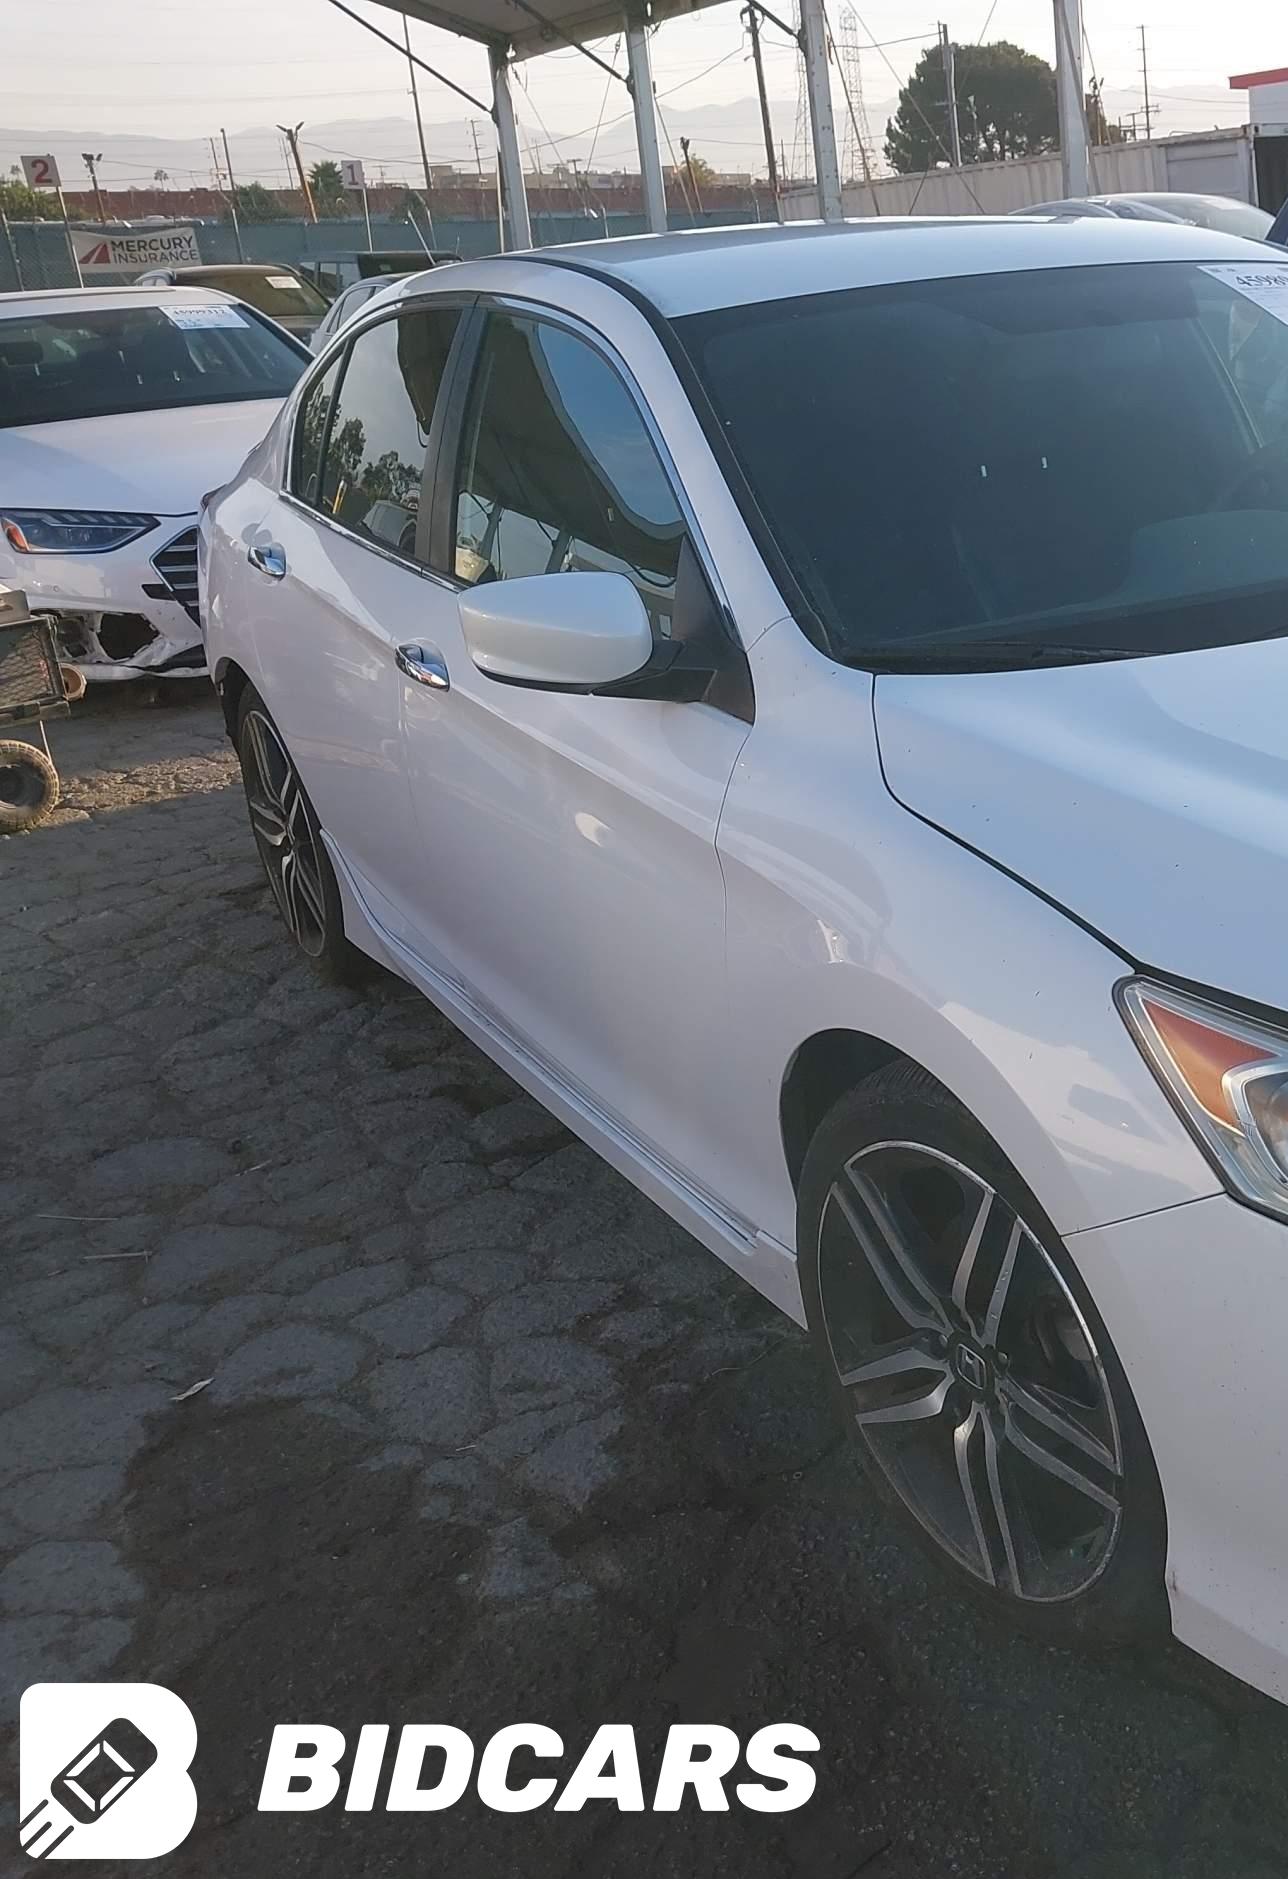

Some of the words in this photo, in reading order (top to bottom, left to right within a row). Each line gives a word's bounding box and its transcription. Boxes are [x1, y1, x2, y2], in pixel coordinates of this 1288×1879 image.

[31, 159, 53, 184] 2
[347, 164, 359, 185] 1
[111, 235, 193, 253] MERCURY
[113, 249, 200, 265] INSURANCE
